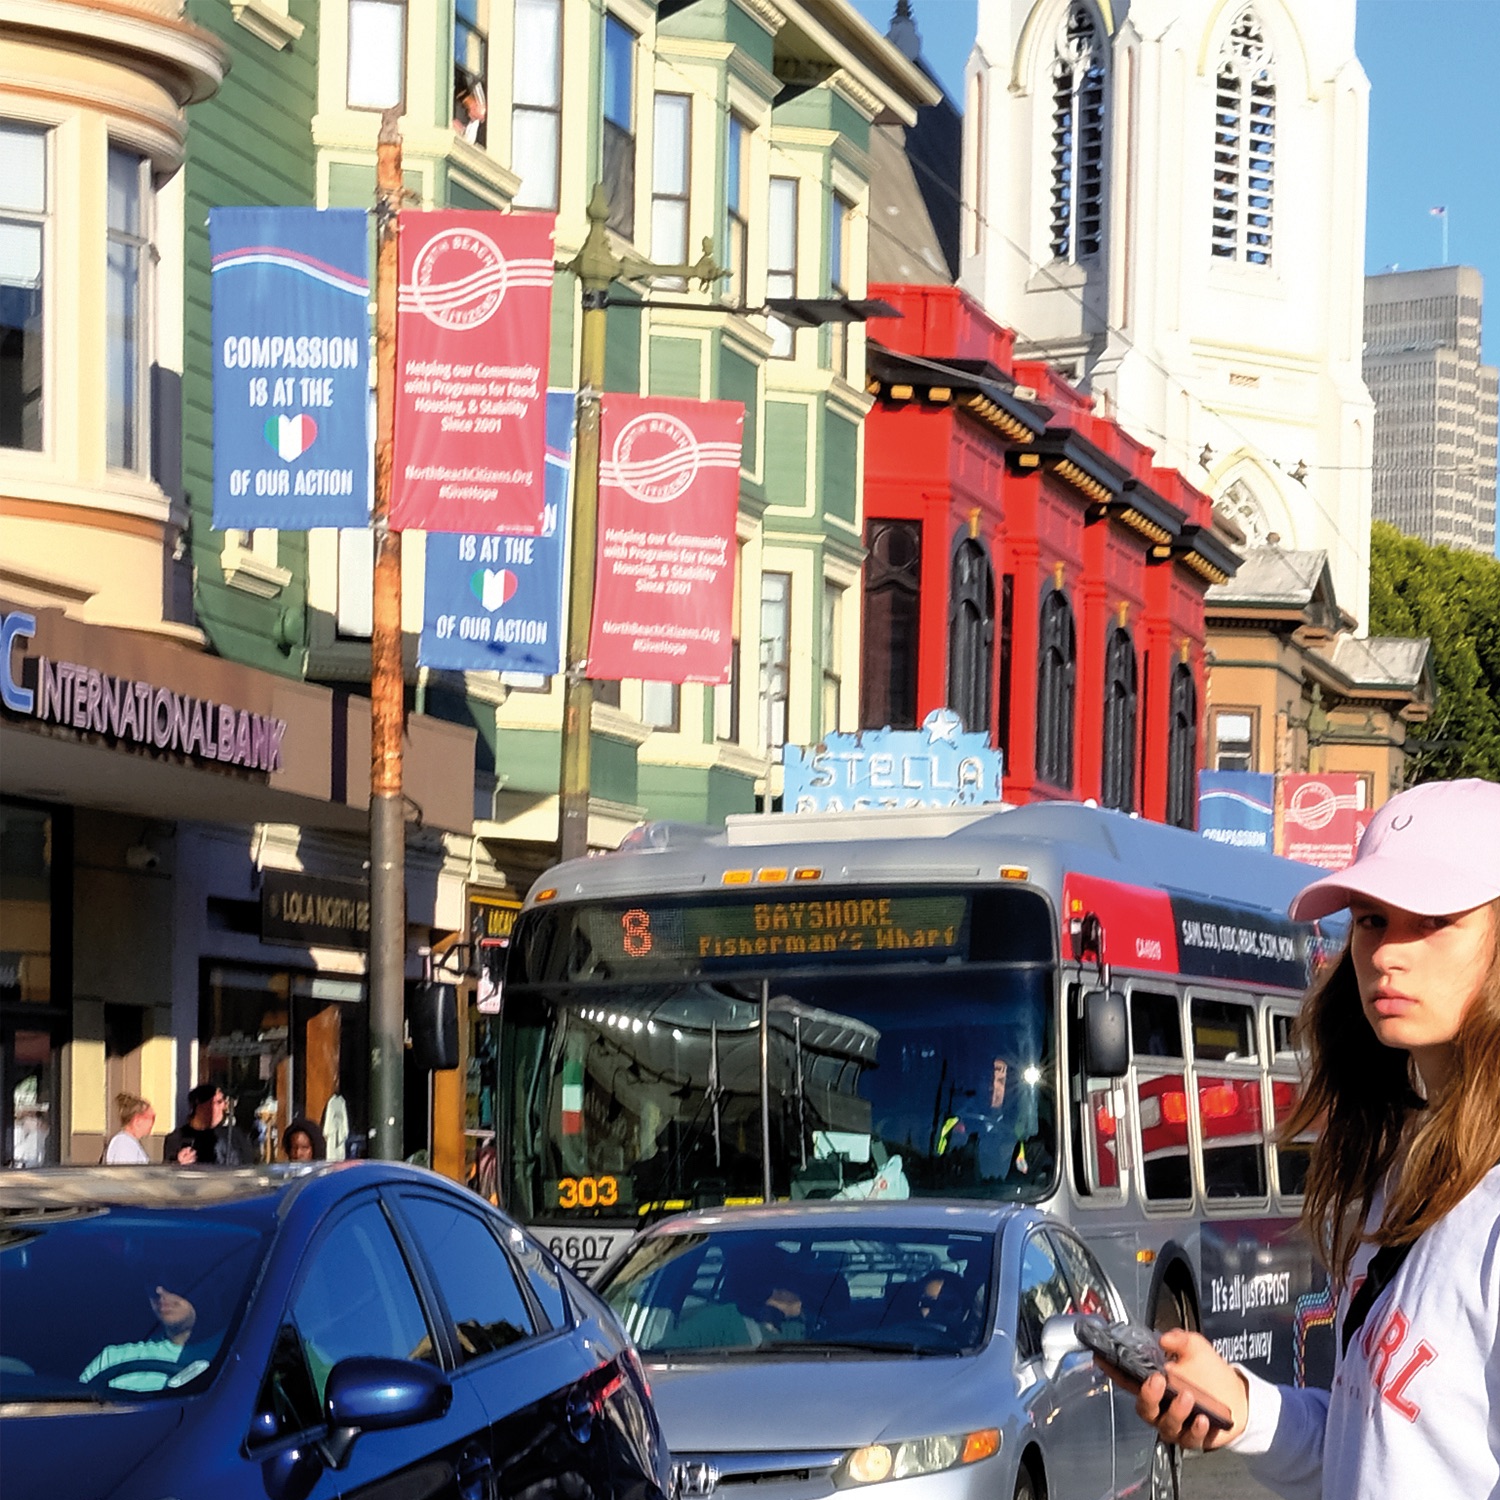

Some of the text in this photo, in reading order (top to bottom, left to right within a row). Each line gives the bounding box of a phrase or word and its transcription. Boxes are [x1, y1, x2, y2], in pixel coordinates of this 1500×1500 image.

[223, 336, 358, 369] COMPASSION
[249, 377, 334, 407] IS AT THE
[230, 469, 352, 496] OF OUR ACTION
[459, 534, 534, 564] IS AT THE
[436, 614, 548, 645] OF OUR ACTION
[809, 751, 984, 791] STELLA
[283, 891, 314, 925] LOLA
[316, 895, 356, 930] NORTH
[753, 898, 894, 931] BAYSHORE
[621, 908, 653, 958] 8
[700, 931, 864, 958] Fisherman's
[558, 1175, 618, 1209] 303
[549, 1236, 614, 1263] 6607
[1212, 1272, 1290, 1318] It's all just a POST
[1249, 1330, 1272, 1365] away
